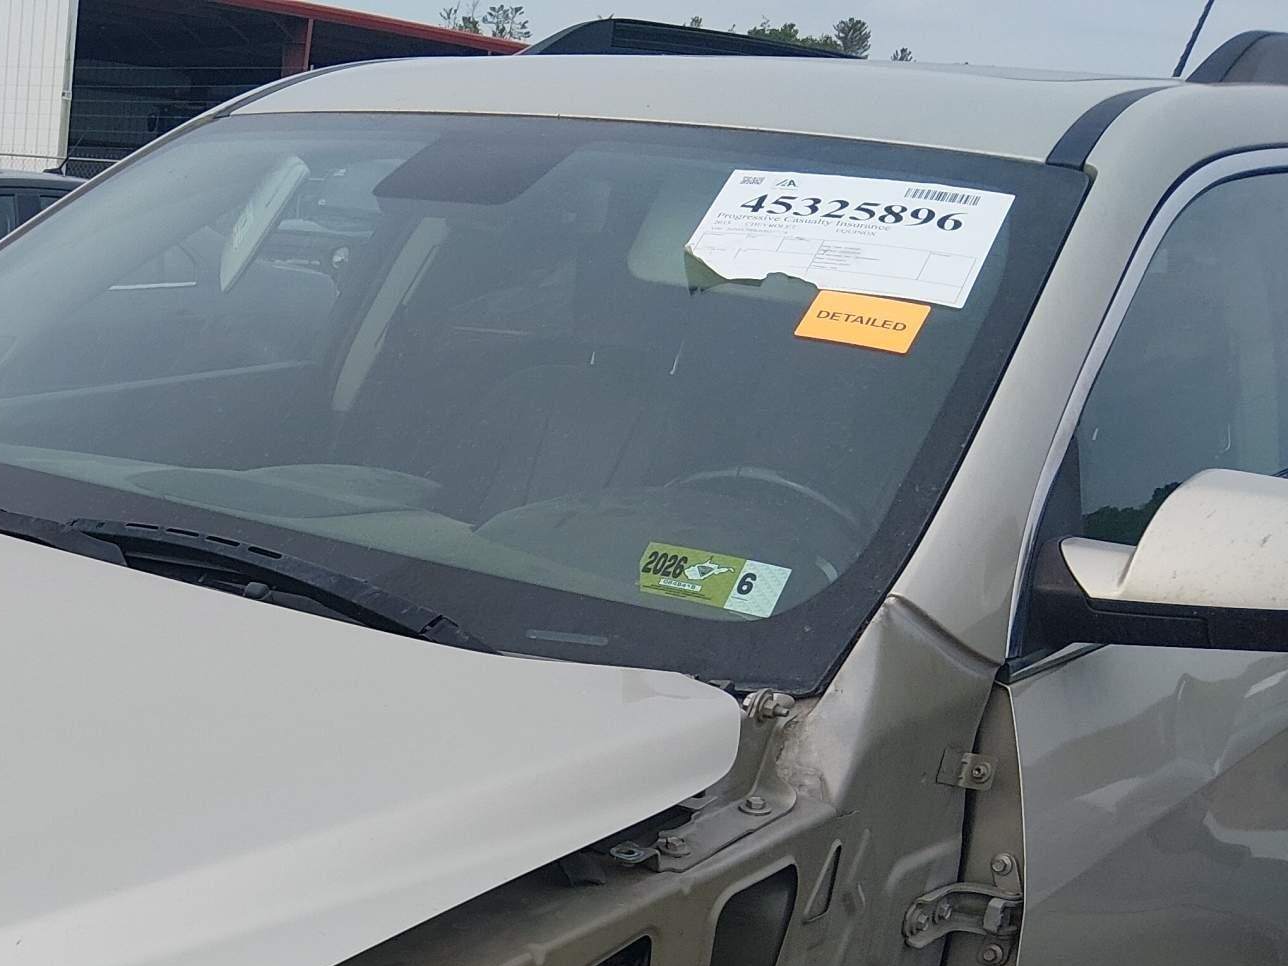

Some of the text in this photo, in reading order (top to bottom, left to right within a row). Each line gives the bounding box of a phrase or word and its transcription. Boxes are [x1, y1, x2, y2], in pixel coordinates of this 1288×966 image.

[716, 211, 892, 232] Progressive Casualty Insurance
[740, 193, 969, 232] 45325896
[816, 310, 907, 332] DETAILED
[641, 551, 688, 579] 2026
[736, 572, 758, 595] 6
